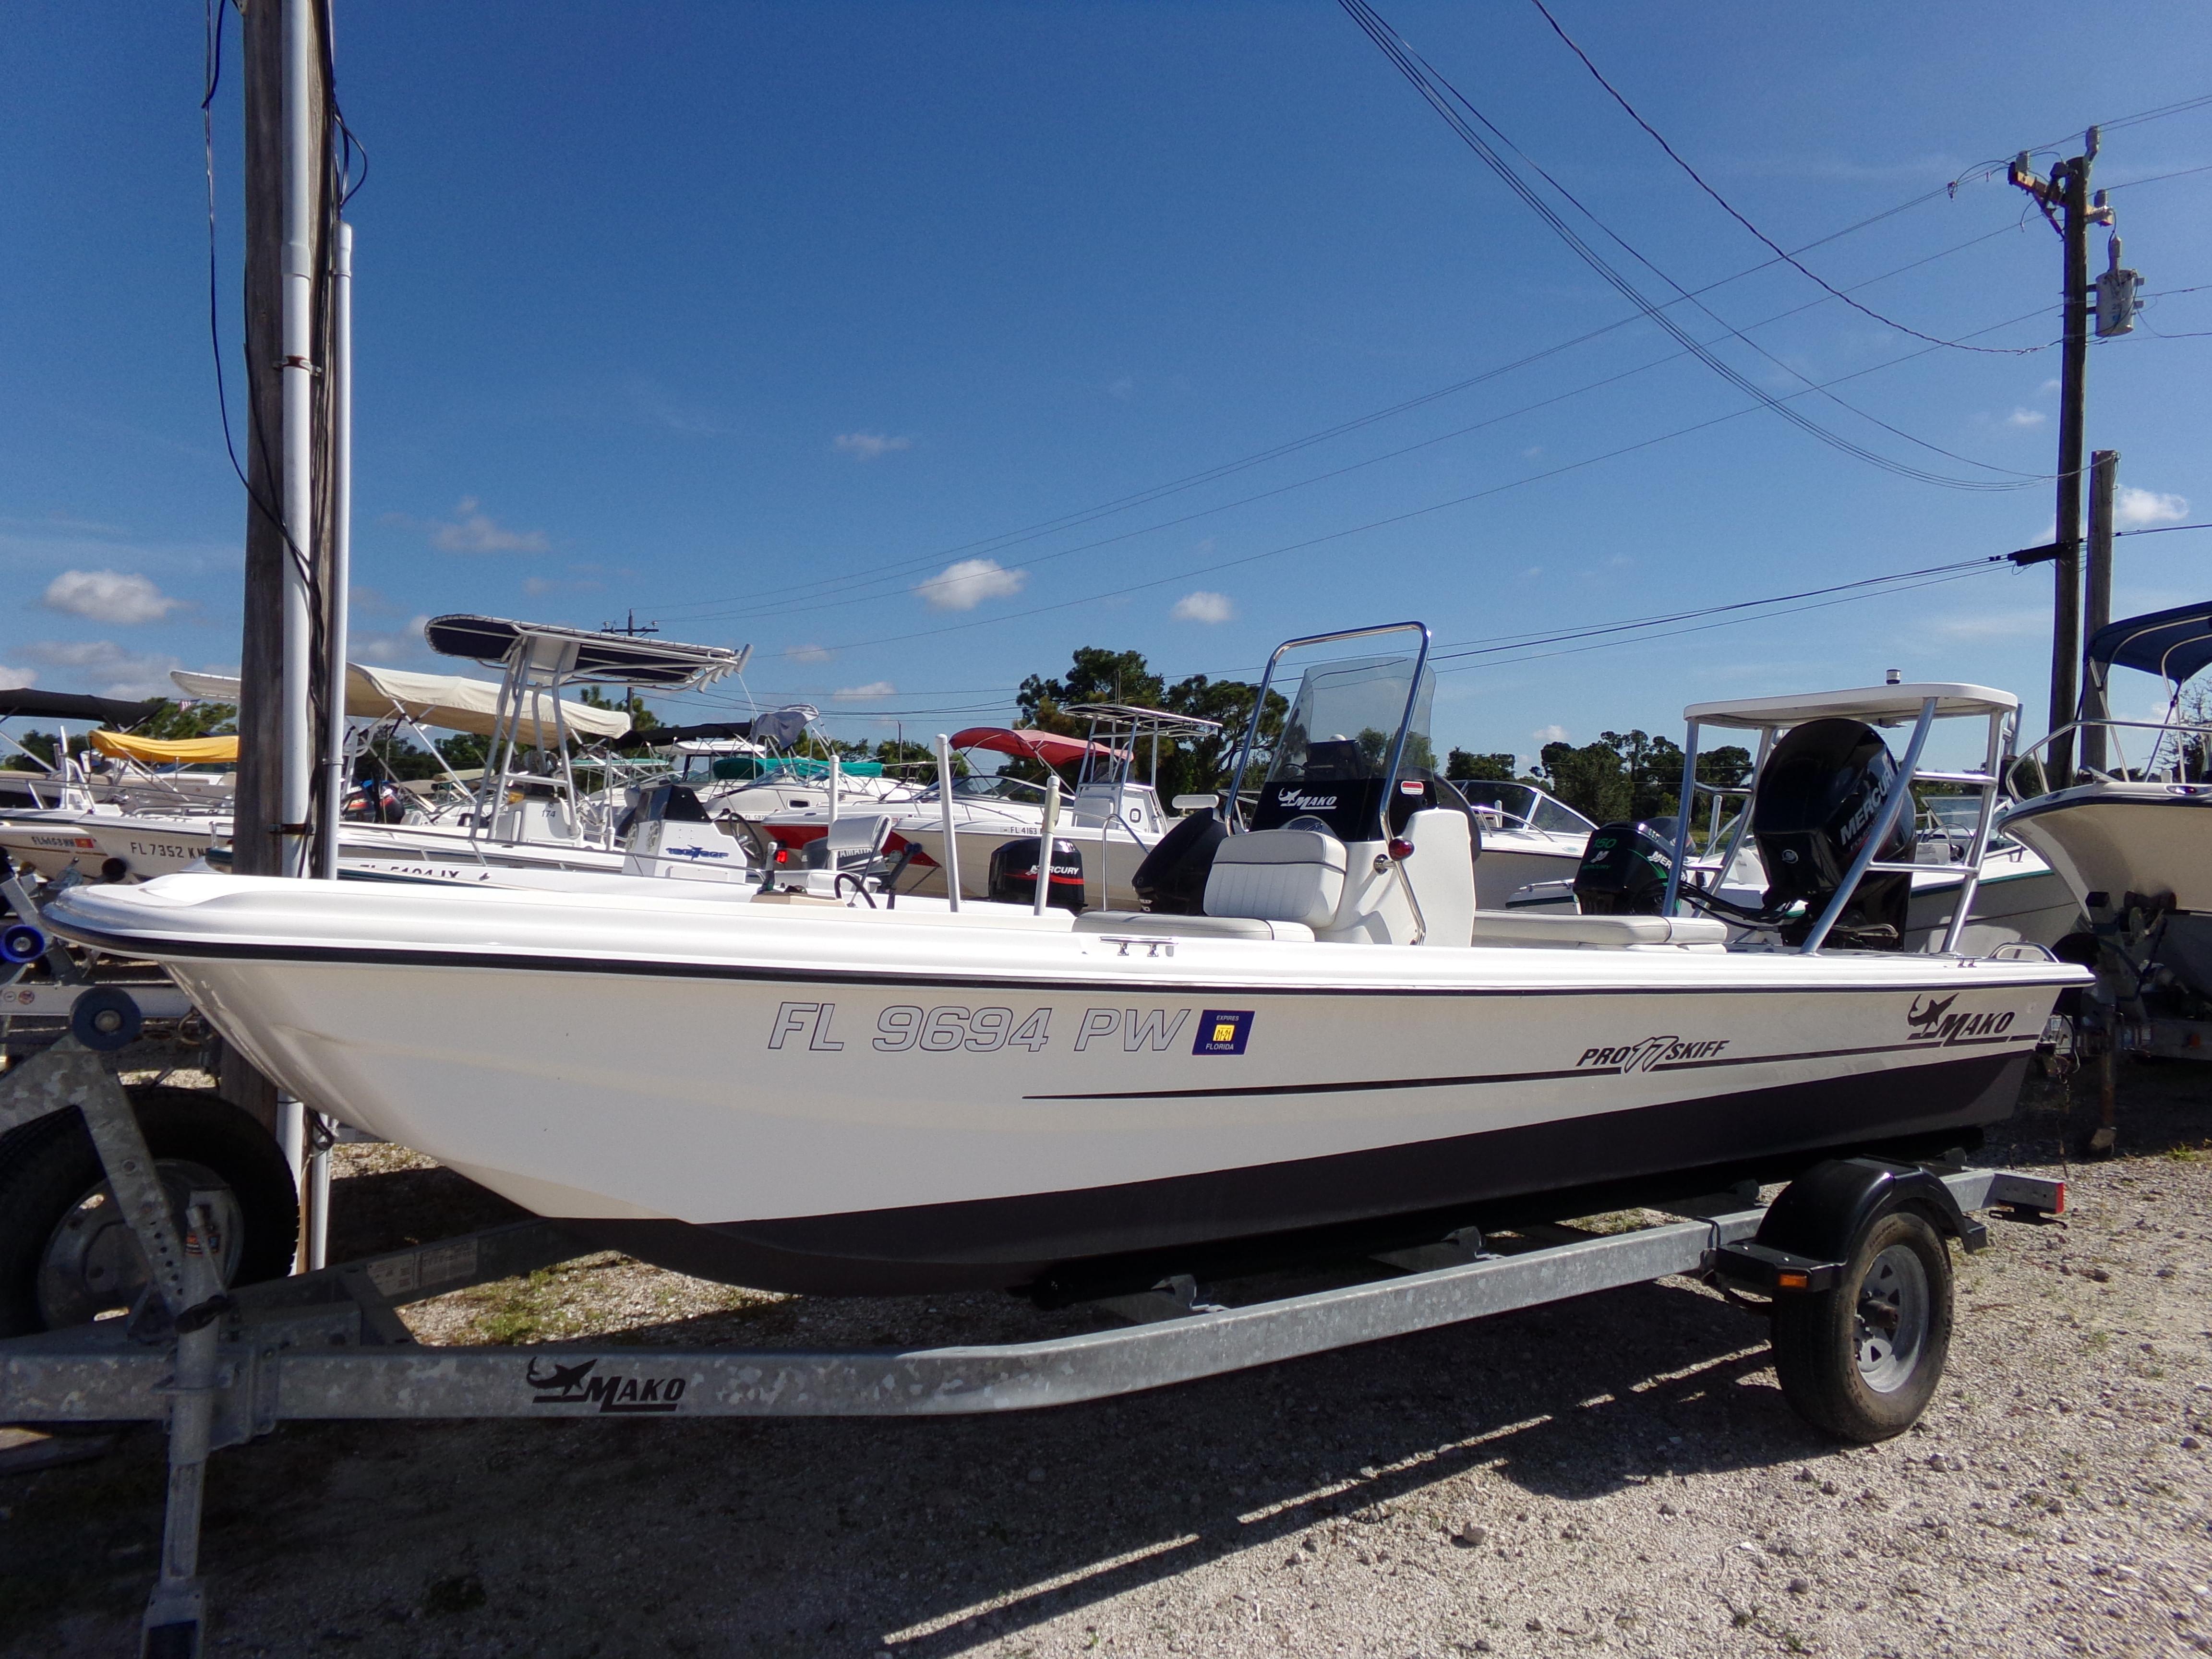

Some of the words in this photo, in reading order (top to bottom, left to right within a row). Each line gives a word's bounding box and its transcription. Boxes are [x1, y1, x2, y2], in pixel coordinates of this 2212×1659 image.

[1295, 796, 1337, 810] MAKO
[1840, 762, 1895, 845] MERCUR
[131, 842, 146, 855] FL
[149, 844, 184, 858] 7352
[1593, 838, 1617, 849] 150
[1025, 865, 1079, 876] MRCURY
[768, 1001, 844, 1051] FL
[872, 1006, 1053, 1053] 9694
[1073, 1008, 1191, 1052] PW
[1937, 1011, 2015, 1047] MAKO
[1575, 1046, 1631, 1067] PRO
[1665, 1040, 1731, 1060] SKIFF
[583, 1376, 686, 1413] MAKO
